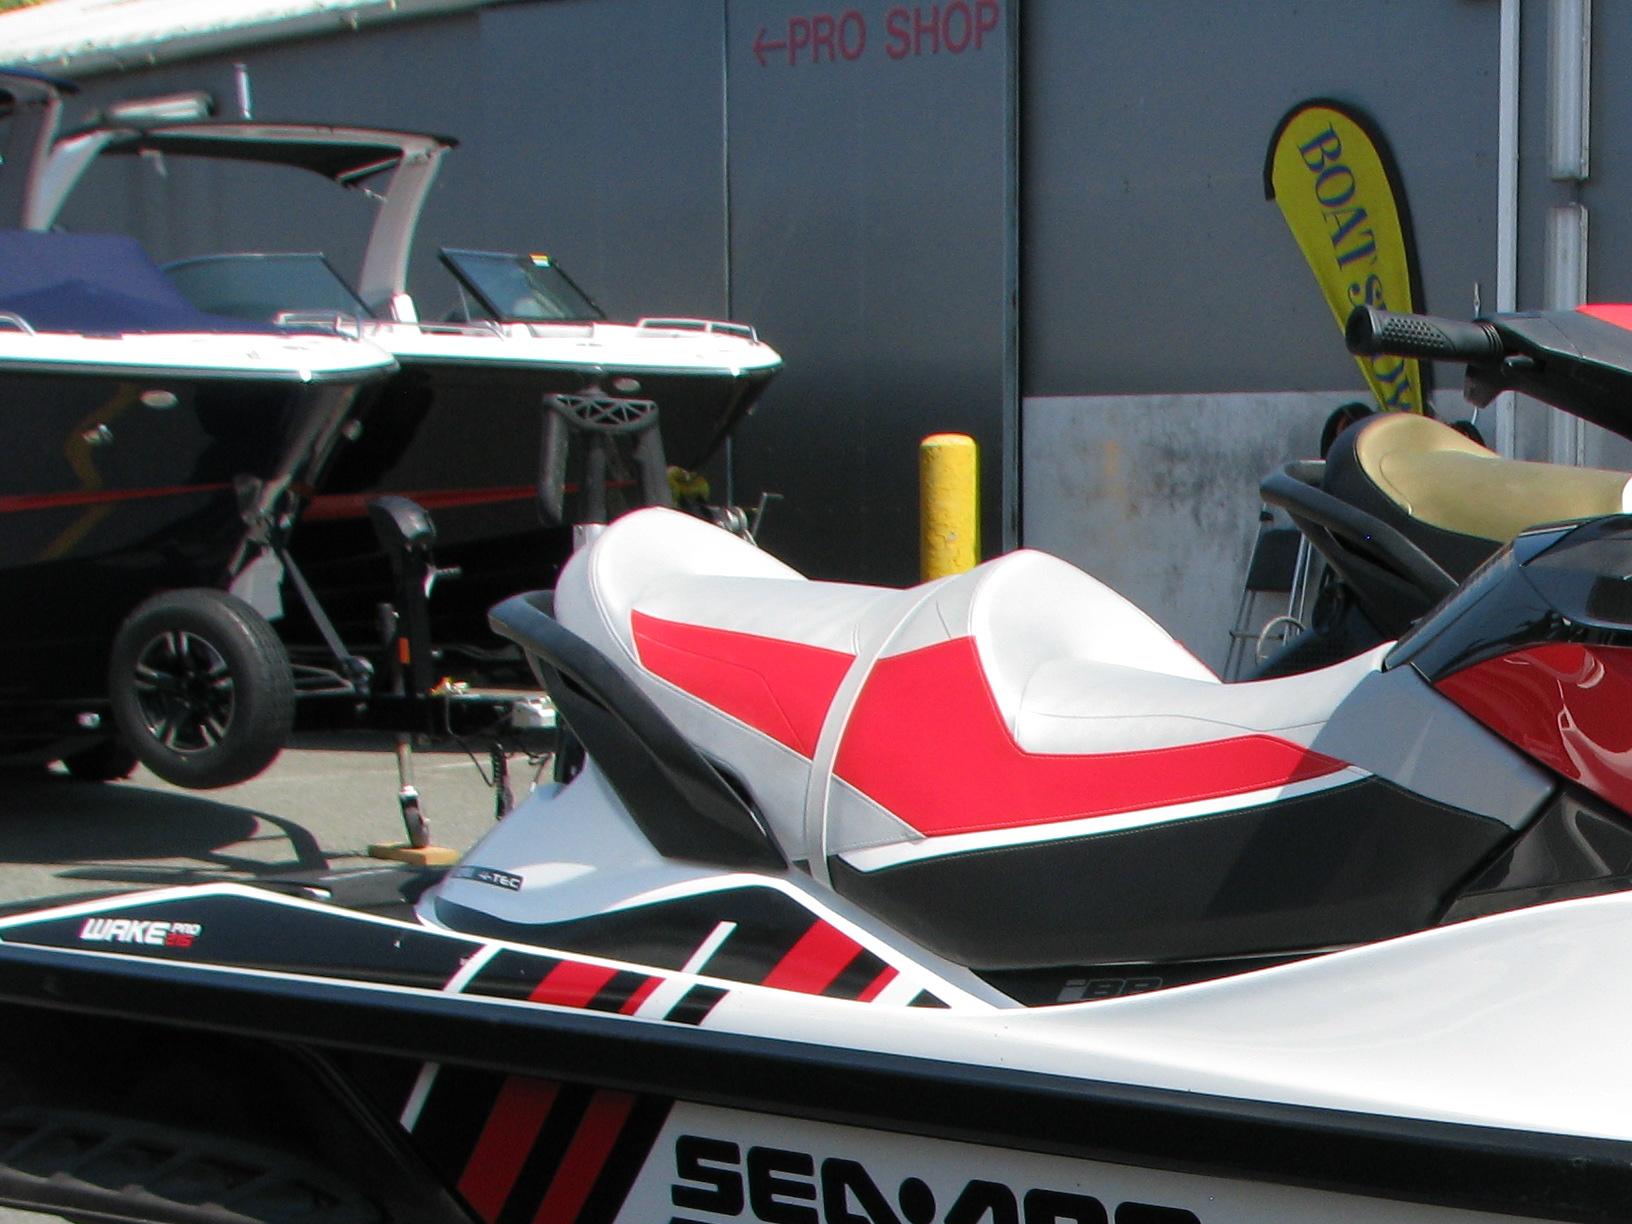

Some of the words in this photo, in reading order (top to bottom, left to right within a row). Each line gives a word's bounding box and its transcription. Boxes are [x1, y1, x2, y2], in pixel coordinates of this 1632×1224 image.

[786, 9, 867, 66] PRO
[884, 0, 1000, 60] SHOP
[1297, 121, 1379, 271] BOAT
[80, 917, 171, 946] WAKE
